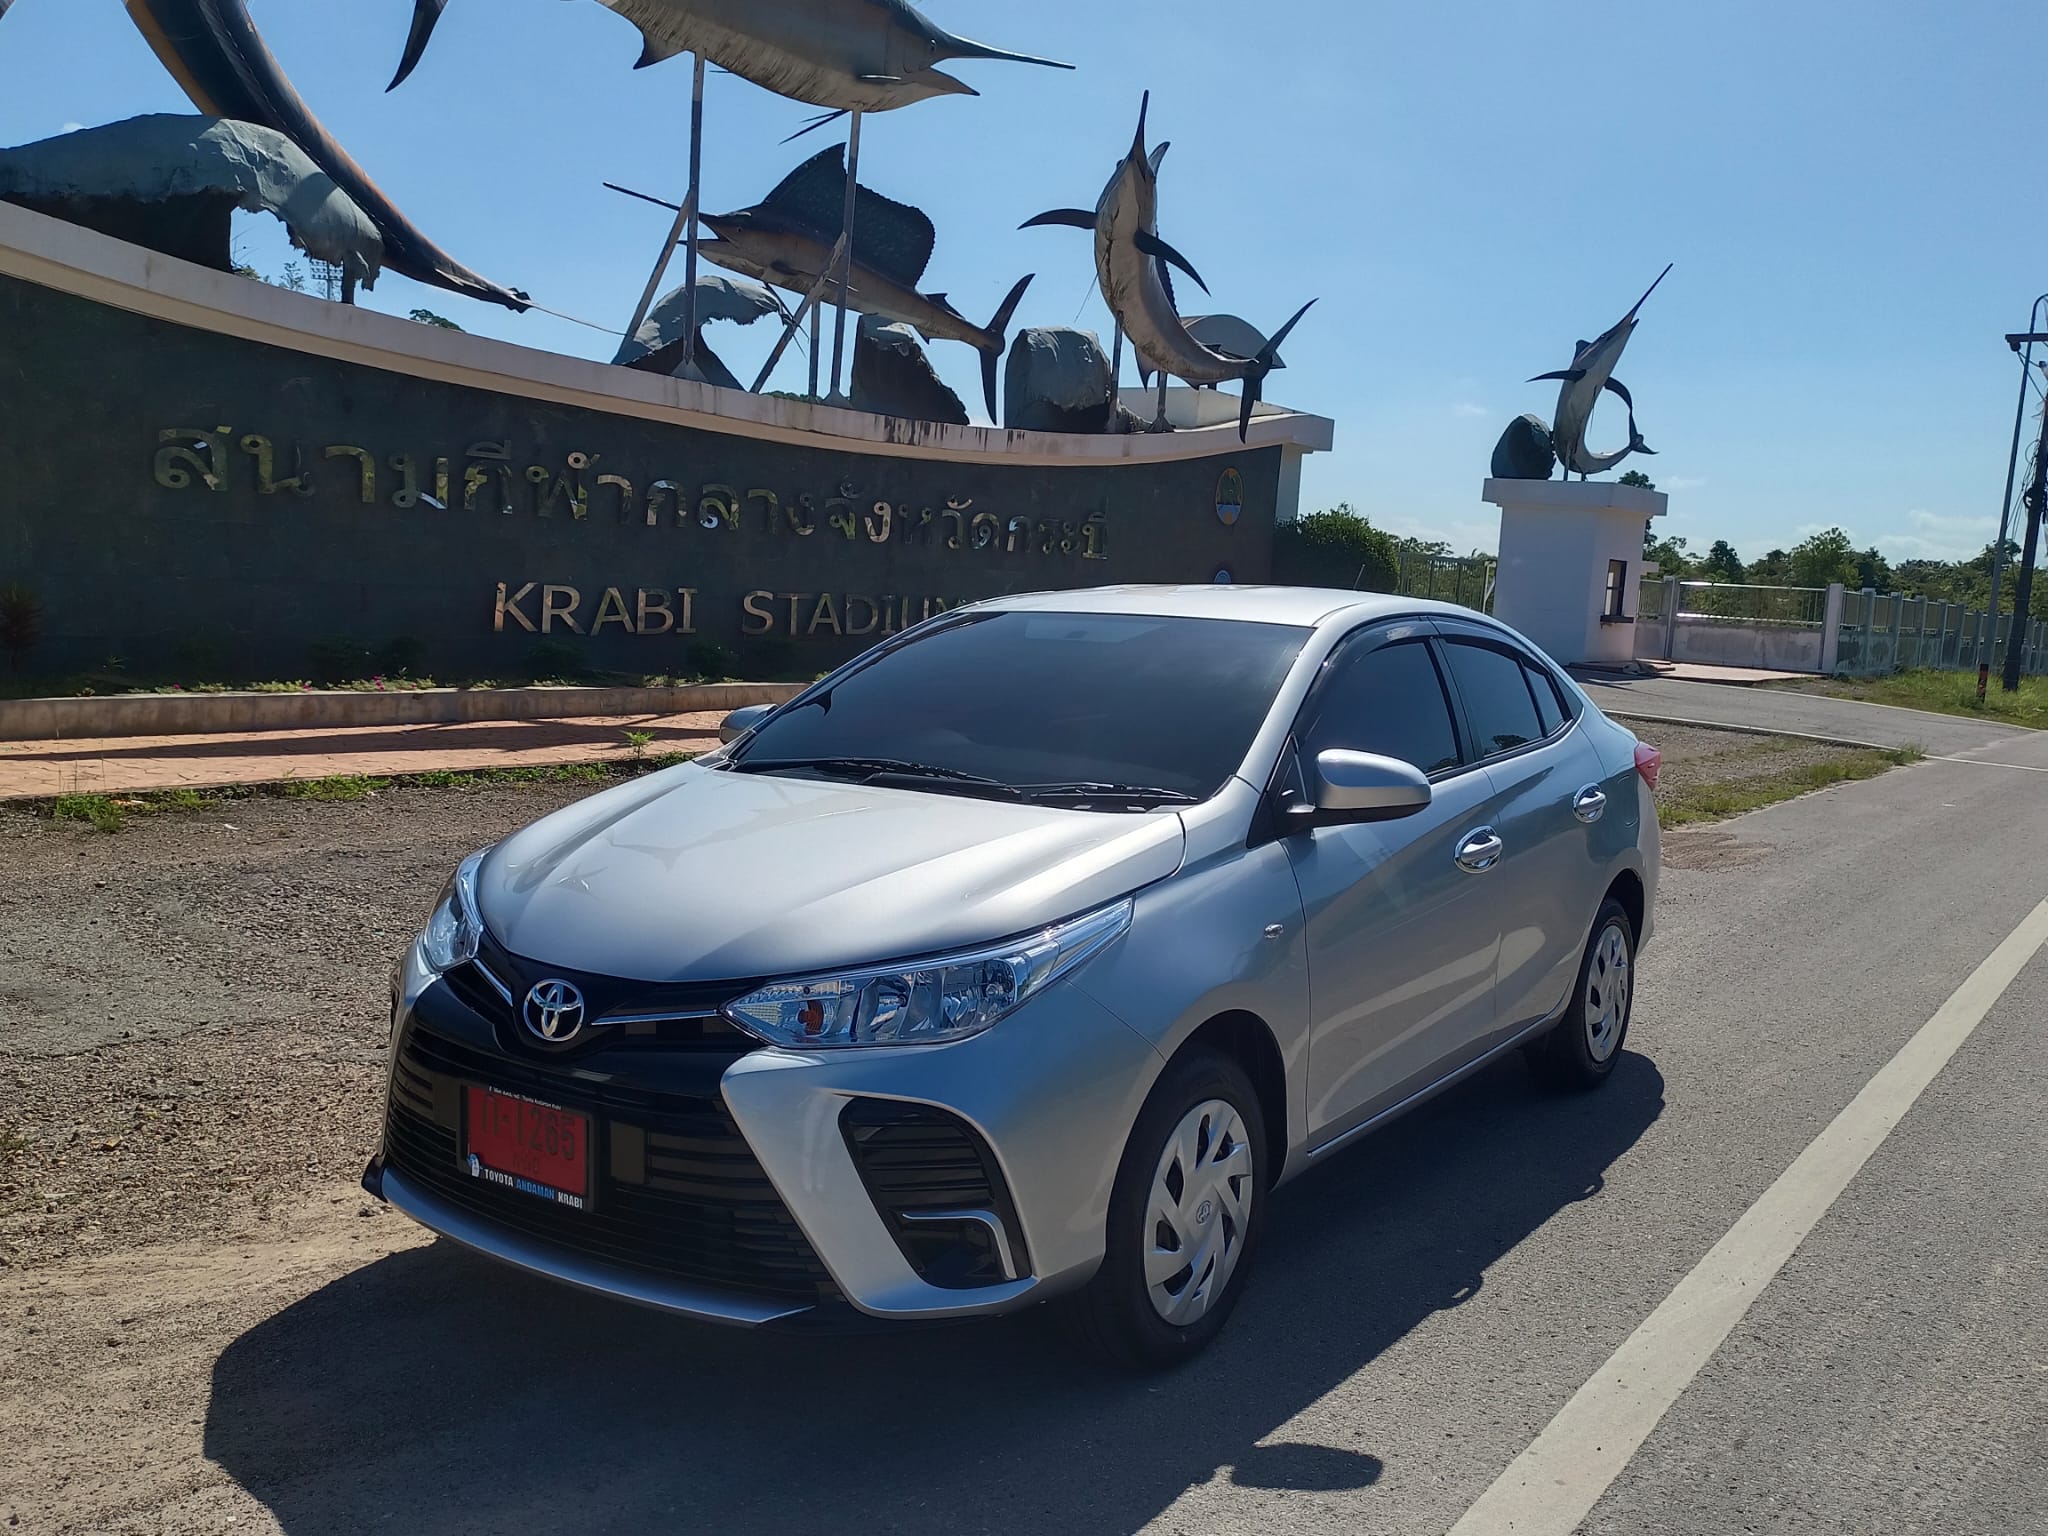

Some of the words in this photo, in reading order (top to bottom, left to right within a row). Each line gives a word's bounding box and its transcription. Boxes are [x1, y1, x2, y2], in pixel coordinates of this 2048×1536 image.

[493, 582, 698, 637] KRABI
[484, 1168, 514, 1188] TOYOTA
[515, 1178, 555, 1200] ANDAMAN
[557, 1191, 583, 1209] KRABI
